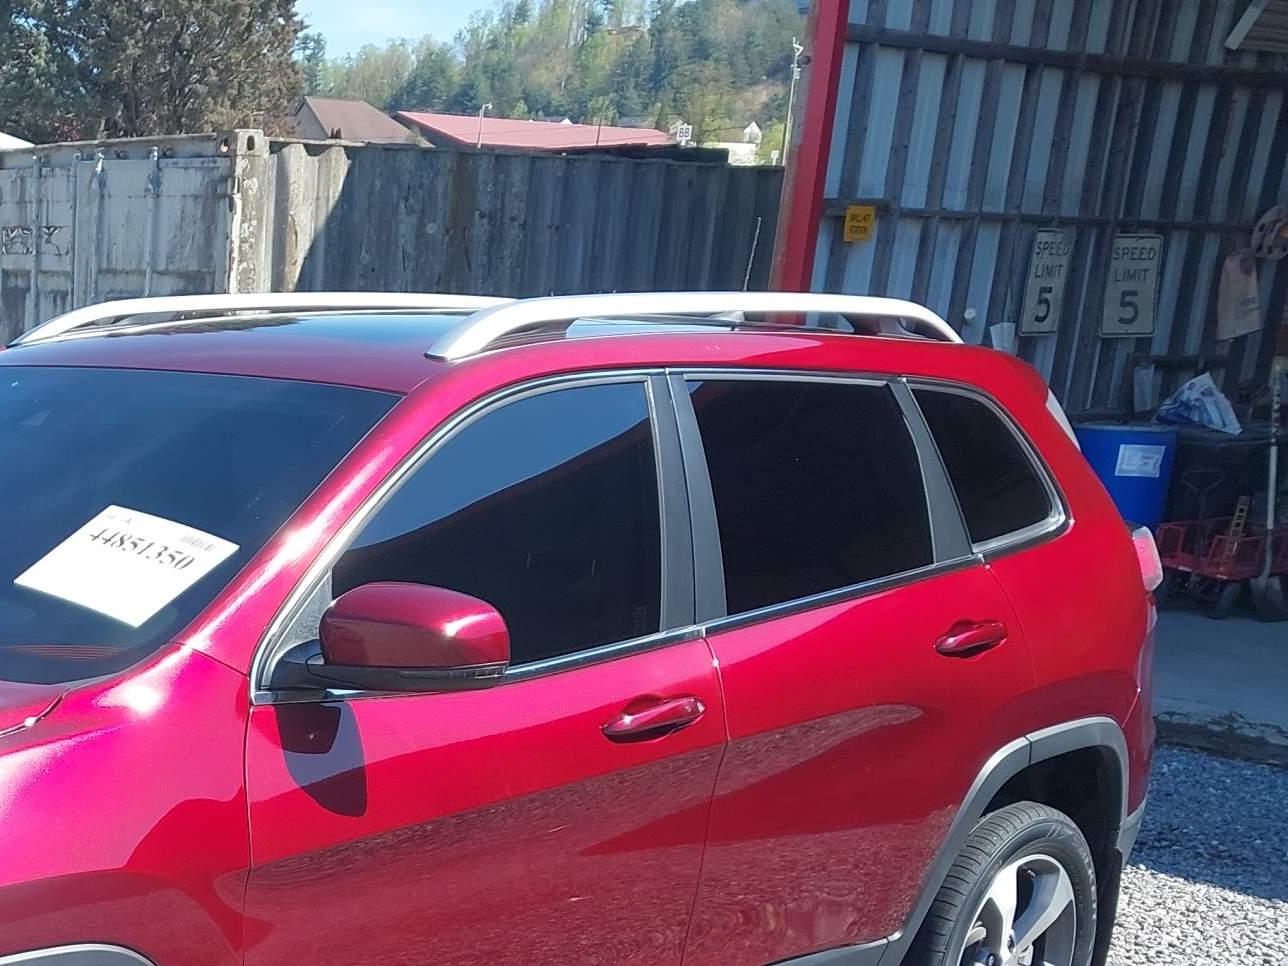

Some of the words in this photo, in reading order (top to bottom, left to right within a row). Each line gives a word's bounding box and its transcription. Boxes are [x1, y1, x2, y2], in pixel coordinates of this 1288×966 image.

[1035, 241, 1071, 256] SPEED
[1112, 246, 1157, 261] SPEED
[1034, 264, 1064, 279] LIMIT
[1114, 268, 1149, 282] LIMIT
[1034, 286, 1053, 323] 5
[1117, 289, 1139, 325] 5
[89, 528, 195, 570] 44851350
